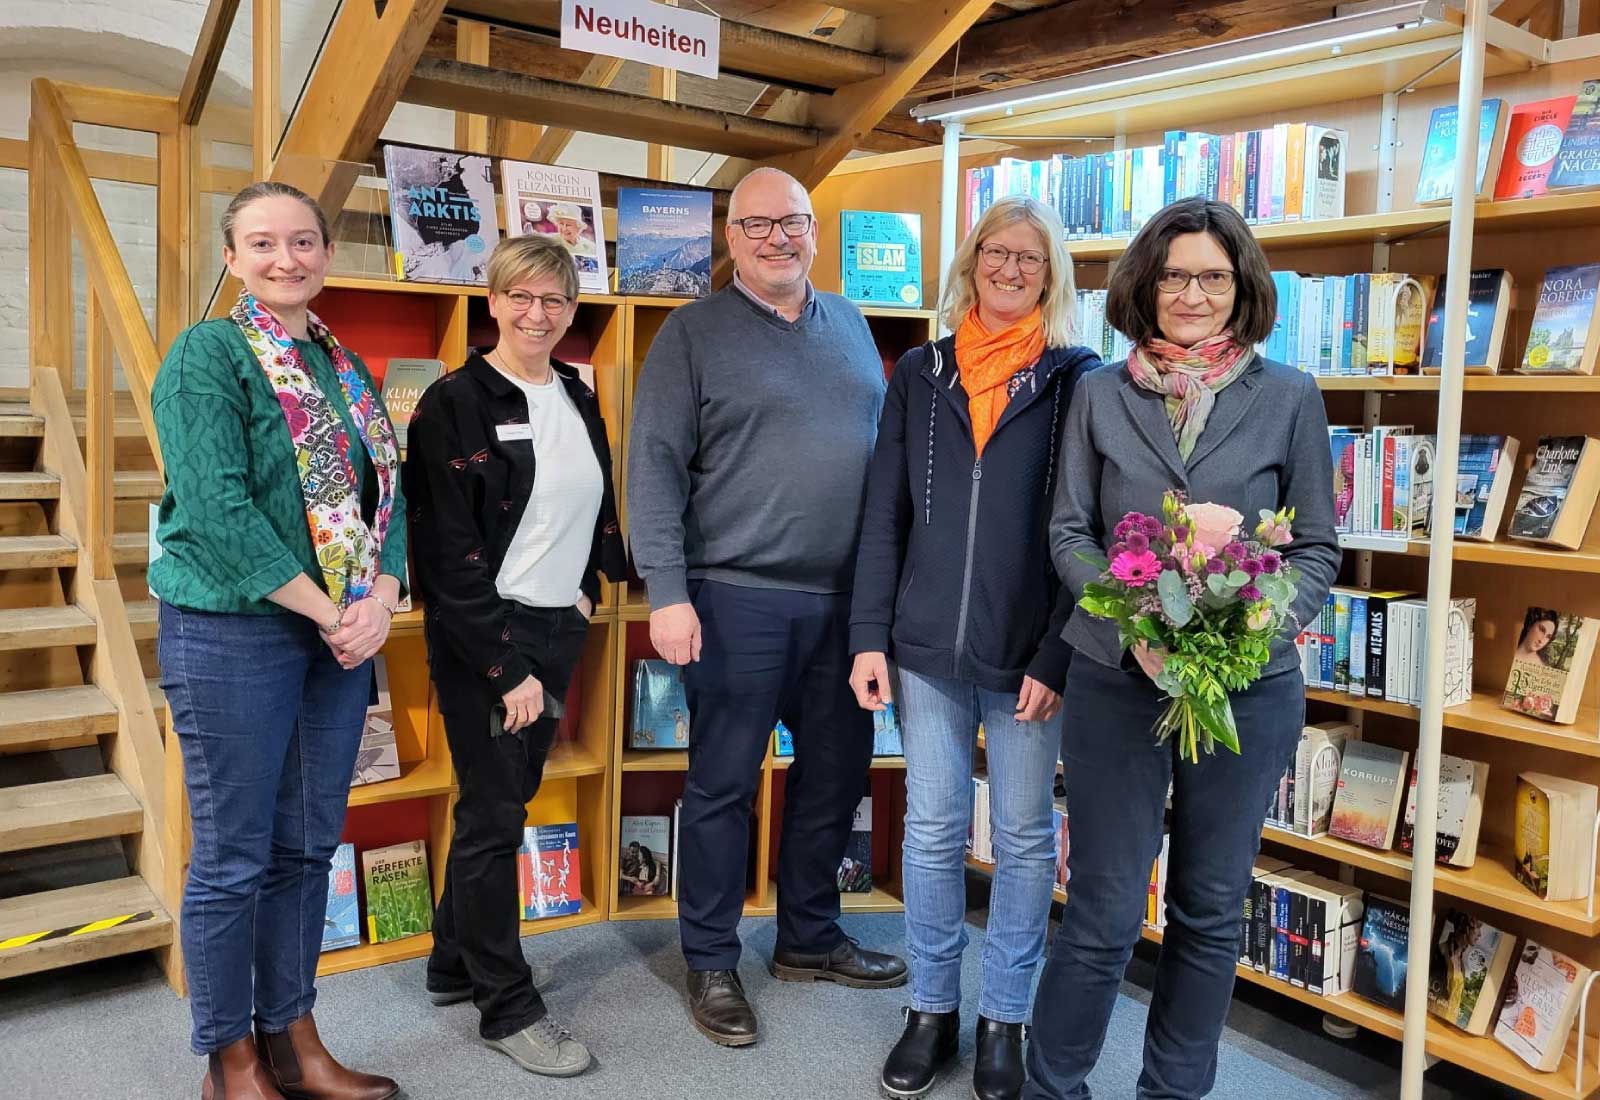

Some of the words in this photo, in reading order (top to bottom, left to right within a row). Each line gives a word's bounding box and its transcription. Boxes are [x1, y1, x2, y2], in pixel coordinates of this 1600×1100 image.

[574, 4, 706, 57] Neuheiten
[407, 184, 449, 203] ANT
[517, 178, 580, 197] ELIZABETH
[408, 201, 481, 222] ARKTIS
[642, 205, 690, 216] BAYERNS
[1541, 277, 1583, 293] NORA
[1539, 288, 1597, 304] ROBERTS
[384, 400, 419, 413] ANGS
[1535, 445, 1580, 461] Charlotte
[1384, 449, 1395, 480] KRAFT
[1541, 459, 1563, 474] Link
[1370, 611, 1383, 655] NIEMALS
[1343, 767, 1396, 786] KORRUPT
[1436, 837, 1457, 849] OYES
[371, 856, 423, 875] PERFEKTE
[372, 870, 408, 885] RASEN
